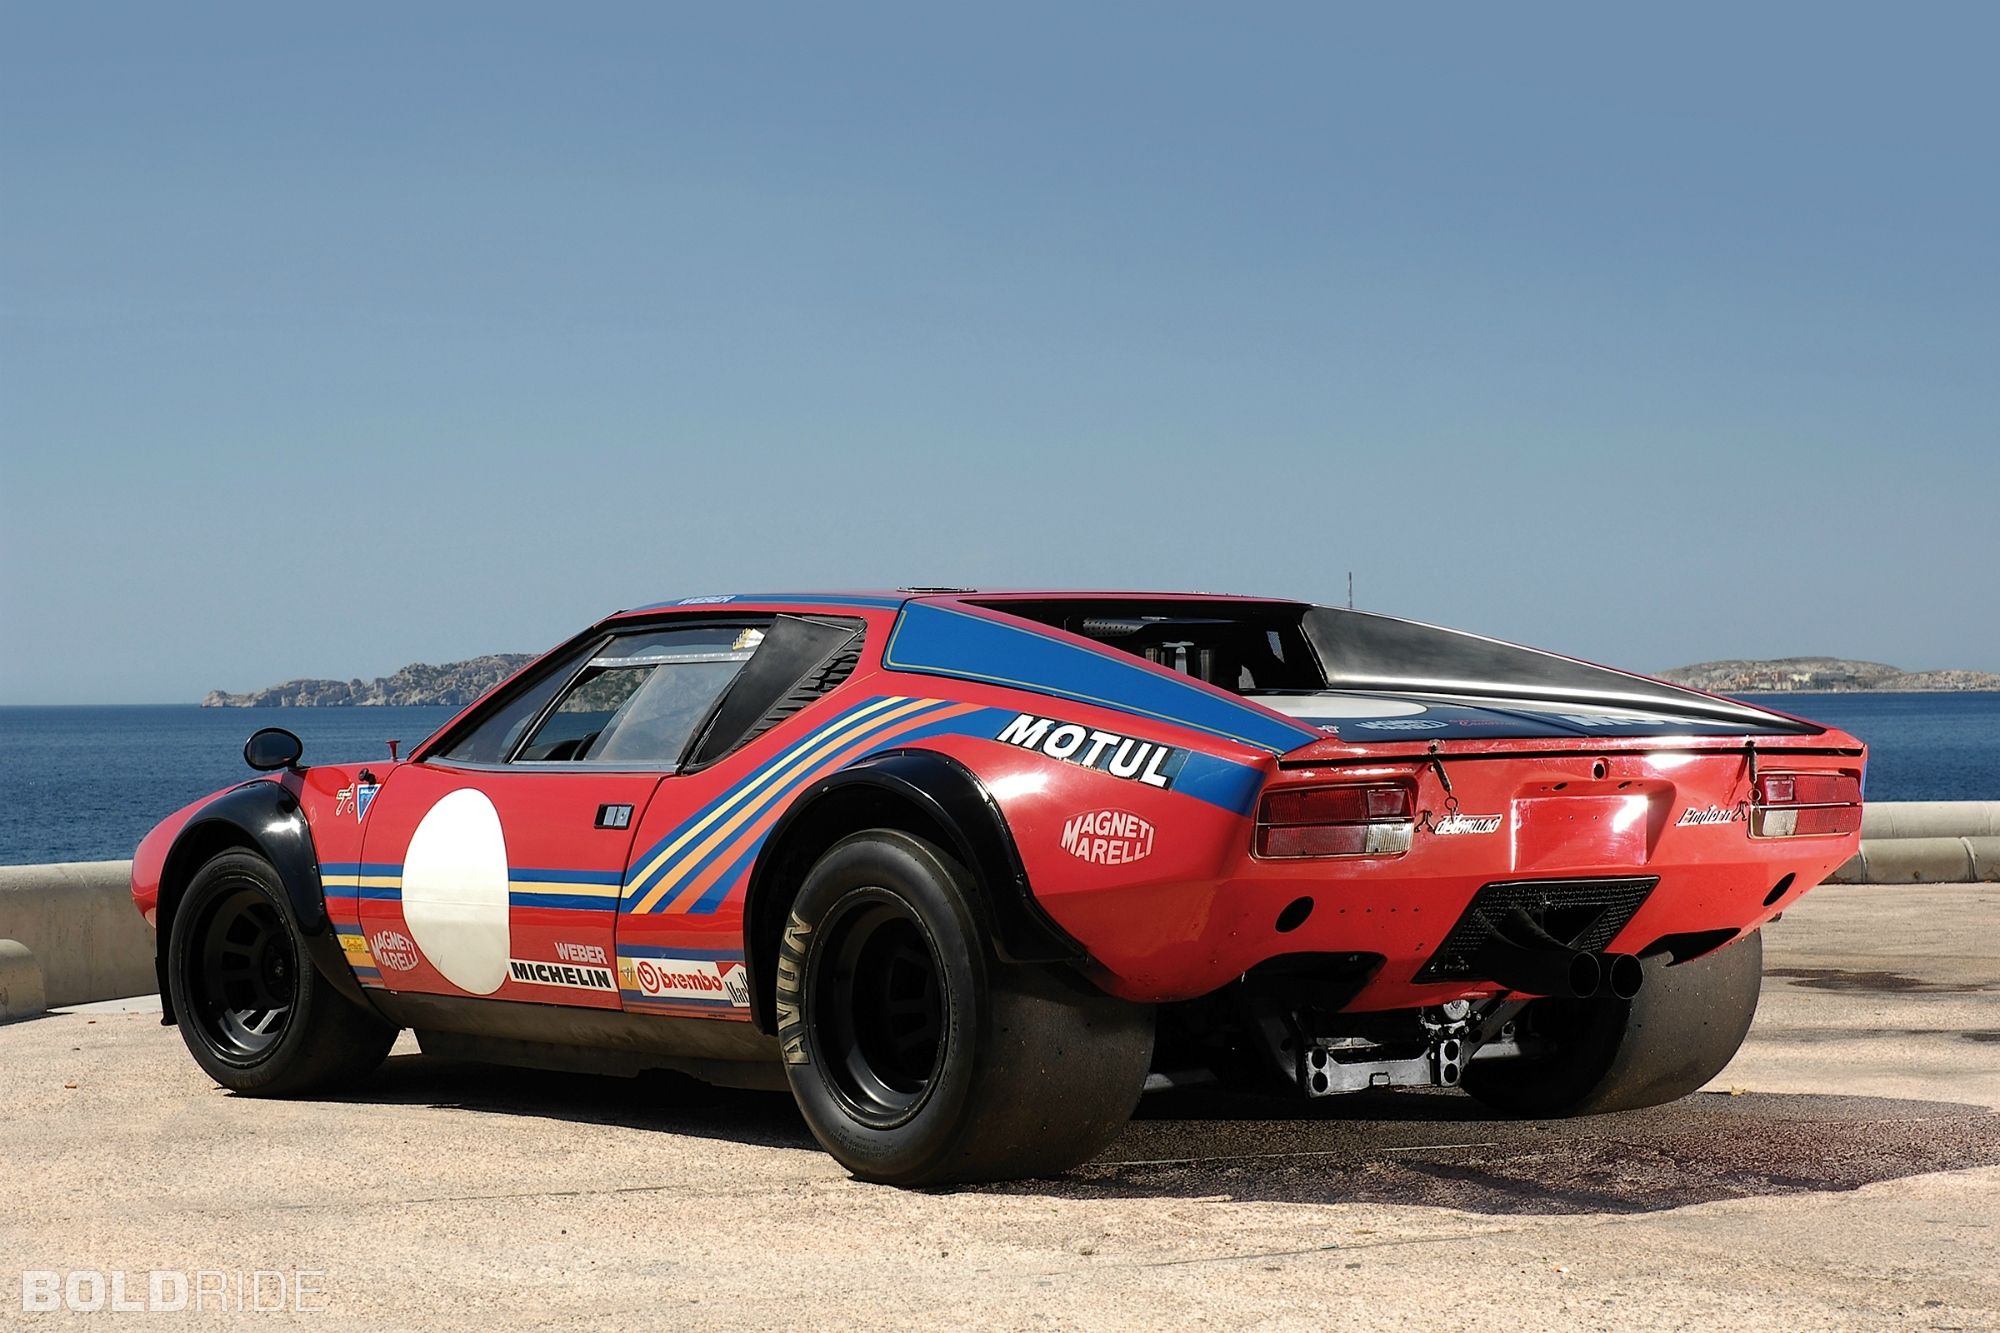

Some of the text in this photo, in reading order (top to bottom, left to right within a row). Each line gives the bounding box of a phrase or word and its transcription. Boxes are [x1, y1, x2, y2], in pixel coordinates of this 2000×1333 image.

[996, 713, 1168, 788] MOTUL
[1674, 804, 1734, 827] Pantera
[1061, 811, 1154, 849] MAGNETI
[1061, 834, 1154, 865] MARELLI
[370, 930, 417, 957] MAGNETI
[554, 942, 608, 964] WEBER
[373, 947, 419, 971] MARELLI
[511, 962, 612, 989] MICHELIN
[658, 967, 723, 991] brembo
[776, 911, 813, 1064] AVON
